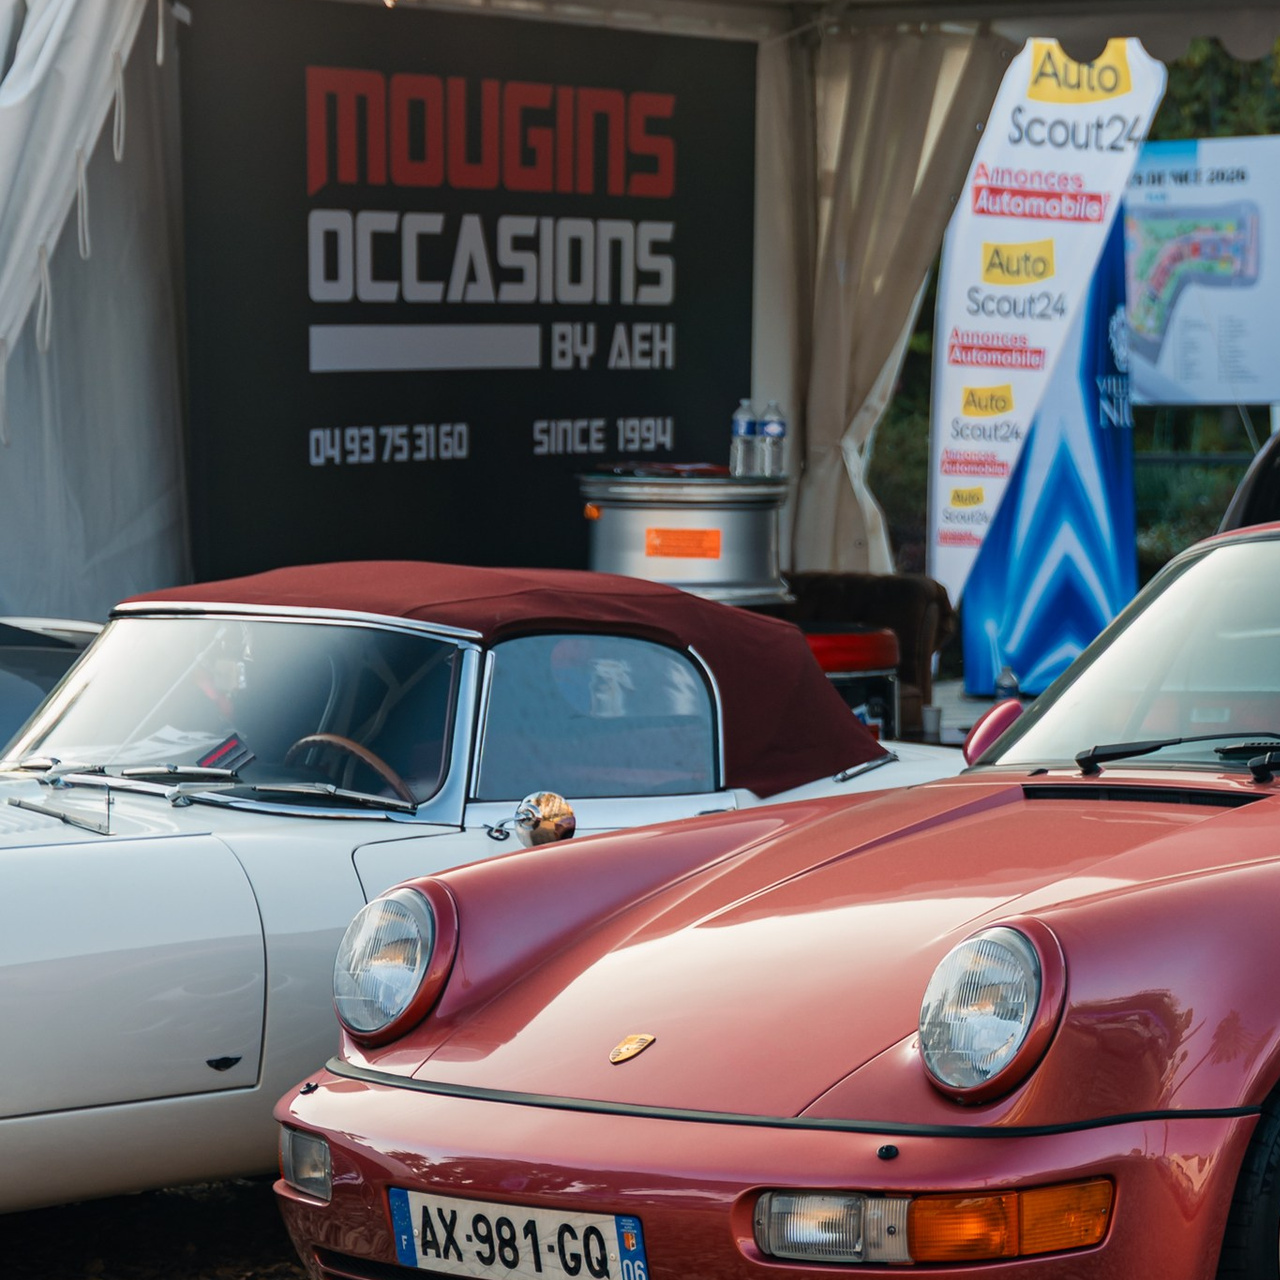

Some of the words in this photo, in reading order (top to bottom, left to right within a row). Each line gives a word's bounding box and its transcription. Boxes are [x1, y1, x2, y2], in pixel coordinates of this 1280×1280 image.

[1033, 49, 1119, 93] Auto
[306, 66, 676, 198] MOUGINS
[1008, 104, 1143, 151] Scout24
[308, 209, 675, 305] OCCASIONS
[985, 247, 1048, 279] Auto
[966, 285, 1066, 320] Scout24
[551, 323, 596, 369] BY
[607, 323, 675, 369] AEH
[963, 390, 1007, 413] Auto
[533, 418, 606, 455] SINCE
[616, 417, 674, 451] 1994
[950, 417, 1022, 442] Scout24
[421, 1205, 611, 1280] AX-981-GQ
